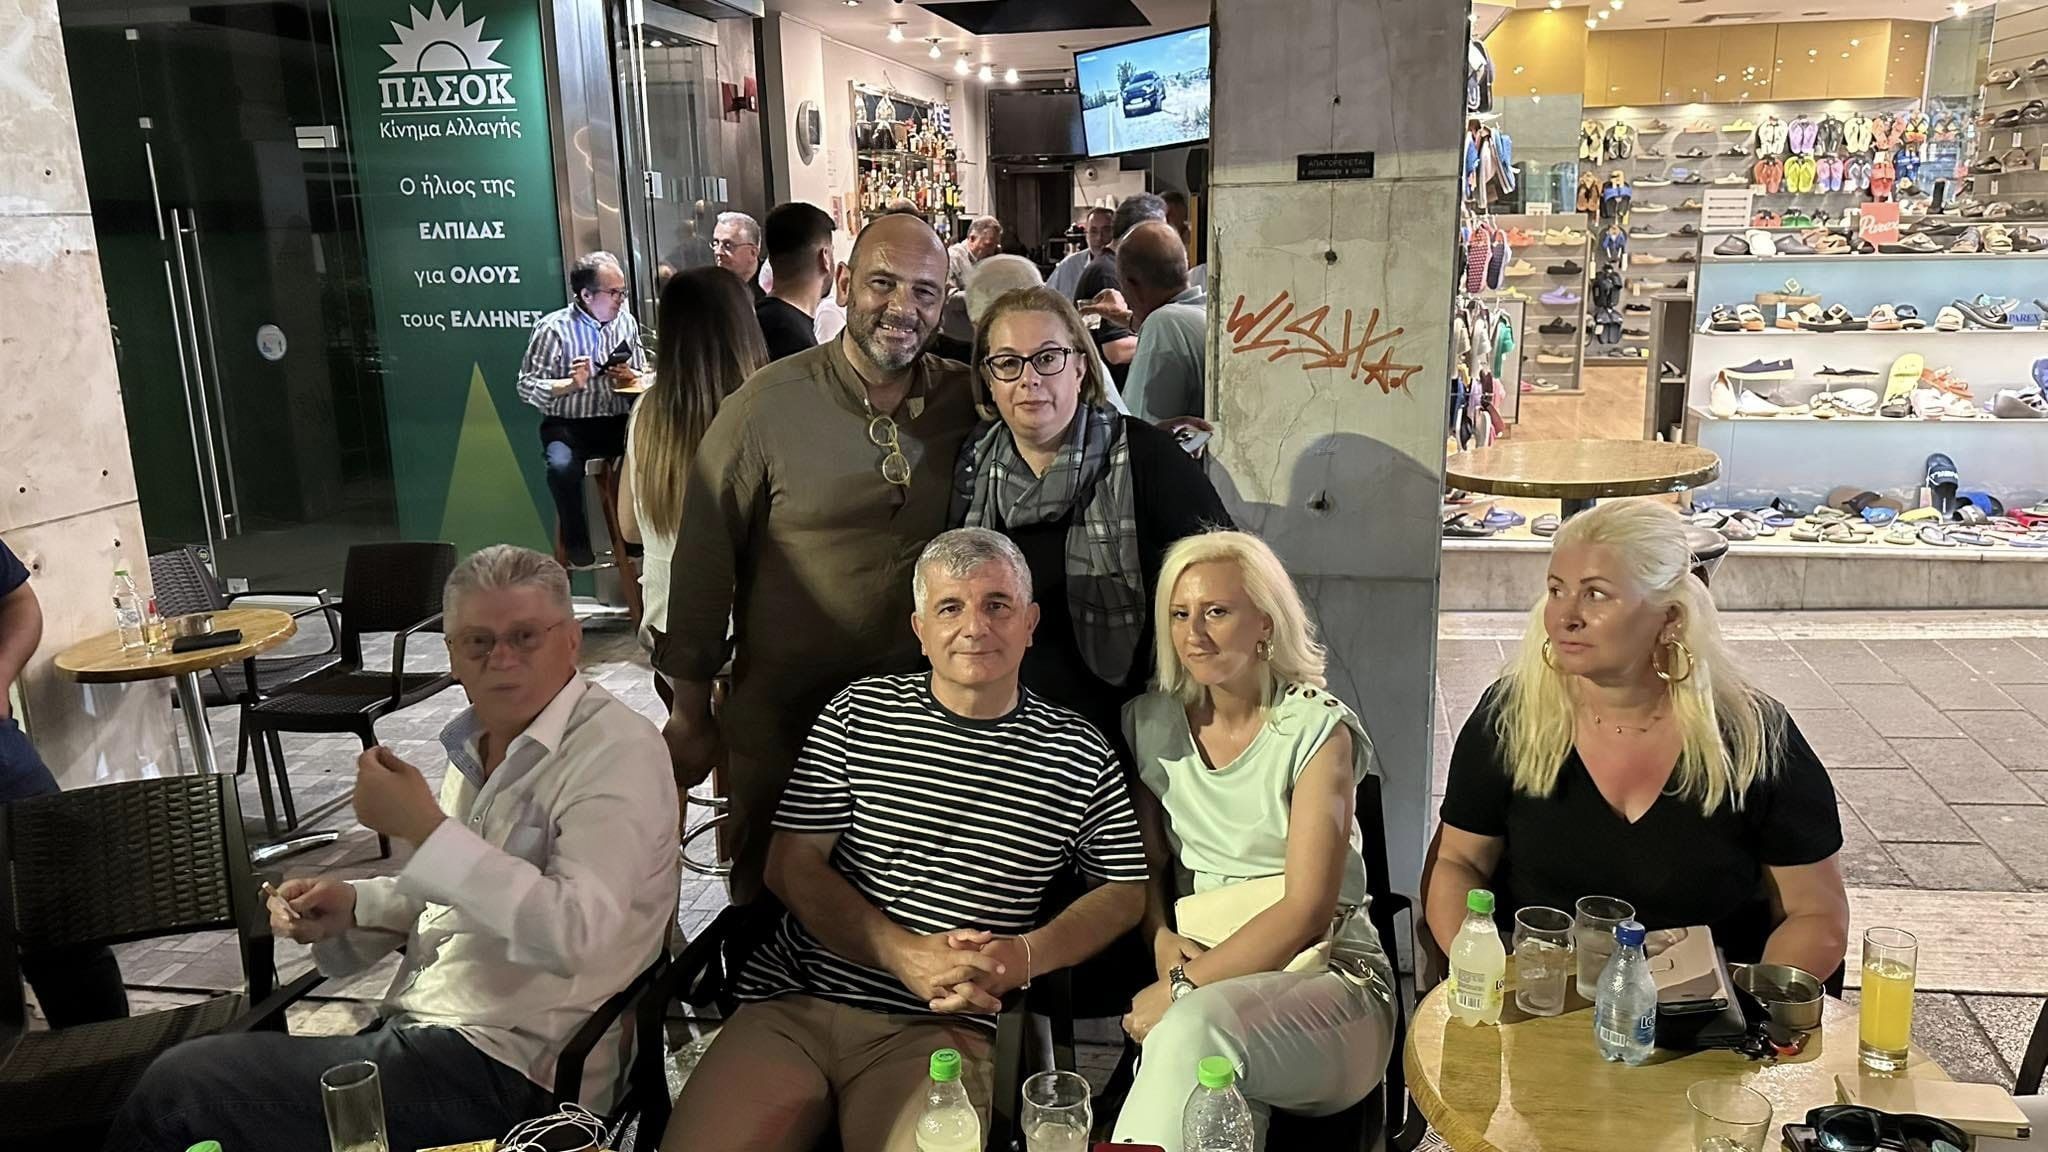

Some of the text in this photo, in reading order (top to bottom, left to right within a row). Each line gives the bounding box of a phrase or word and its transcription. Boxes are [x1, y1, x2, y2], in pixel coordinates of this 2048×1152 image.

[378, 73, 516, 108] ΠΑΣΟΚ
[380, 115, 521, 141] Κίνημα Αλλαγής
[400, 174, 516, 199] Ο ήλιος της
[419, 221, 505, 240] ΕΛΠΙΔΑΣ
[414, 265, 520, 288] για ΟΛΟΥΣ
[401, 313, 446, 331] τους
[2009, 313, 2041, 322] PAREX
